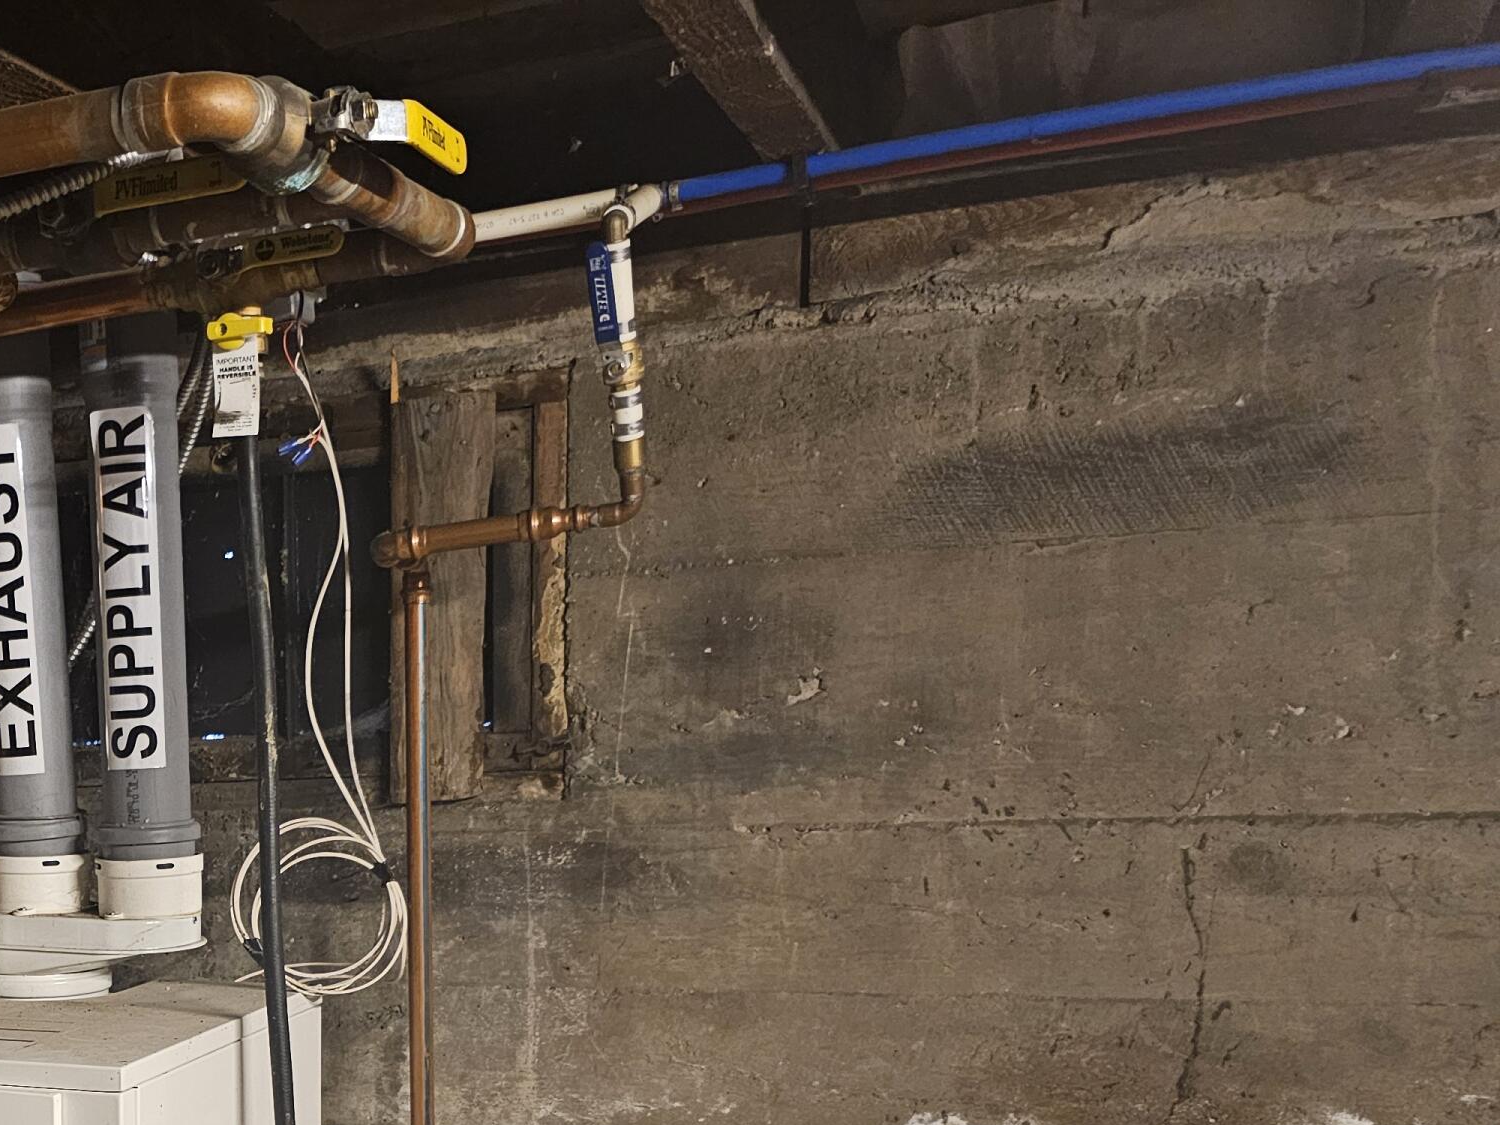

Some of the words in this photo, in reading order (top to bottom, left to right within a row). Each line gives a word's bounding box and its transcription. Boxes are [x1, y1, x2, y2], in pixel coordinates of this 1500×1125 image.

[216, 355, 256, 365] IMPORTANT
[219, 365, 245, 373] HANDLE
[216, 371, 257, 380] REVERSIBLE
[98, 412, 150, 519] AIR
[103, 531, 158, 760] SUPPLY
